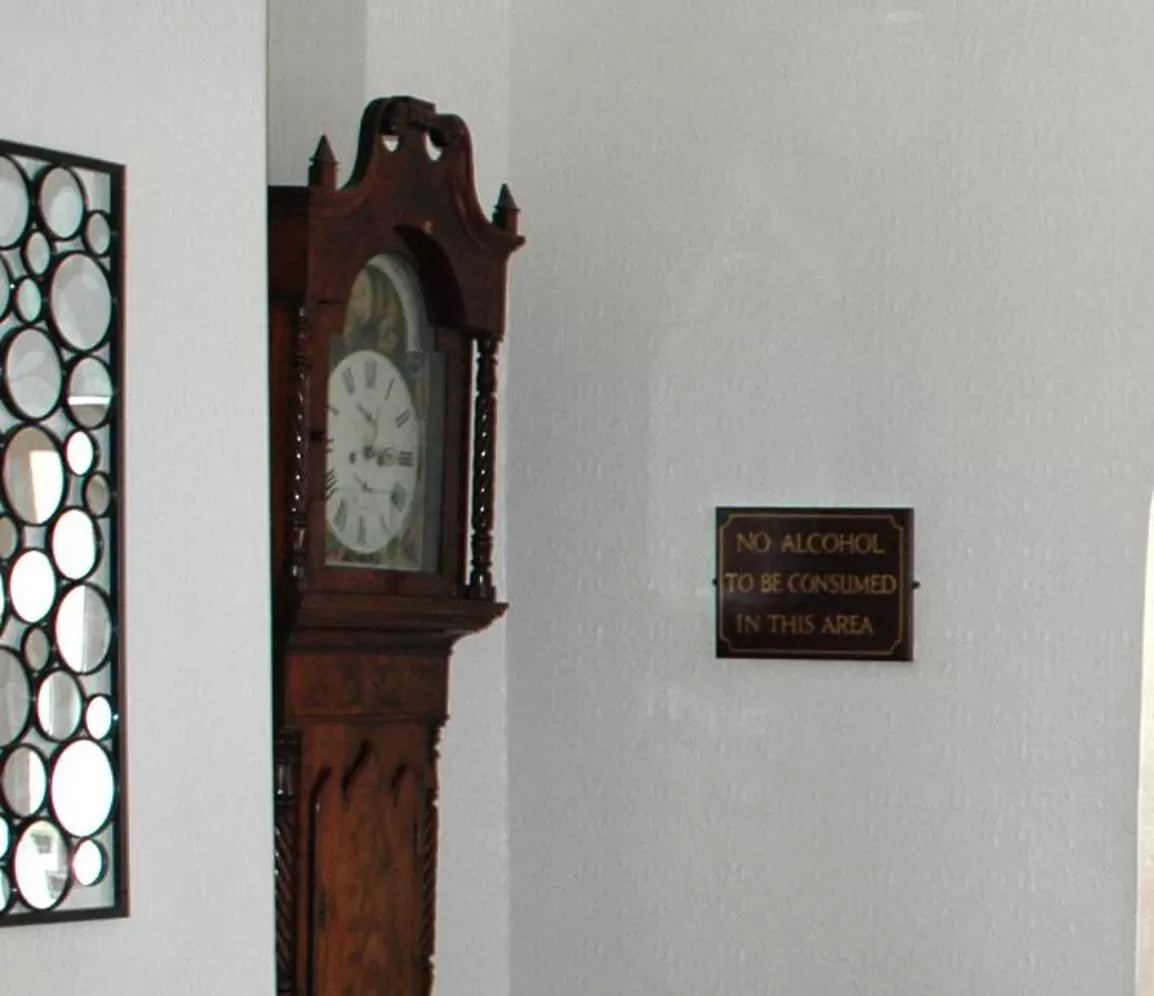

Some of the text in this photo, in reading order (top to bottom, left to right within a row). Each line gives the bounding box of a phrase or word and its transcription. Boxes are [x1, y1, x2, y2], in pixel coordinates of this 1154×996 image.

[736, 532, 885, 554] NO ALCOHOL
[725, 573, 897, 595] TO BE CONSUMED
[736, 614, 874, 634] IN THIS AREA
